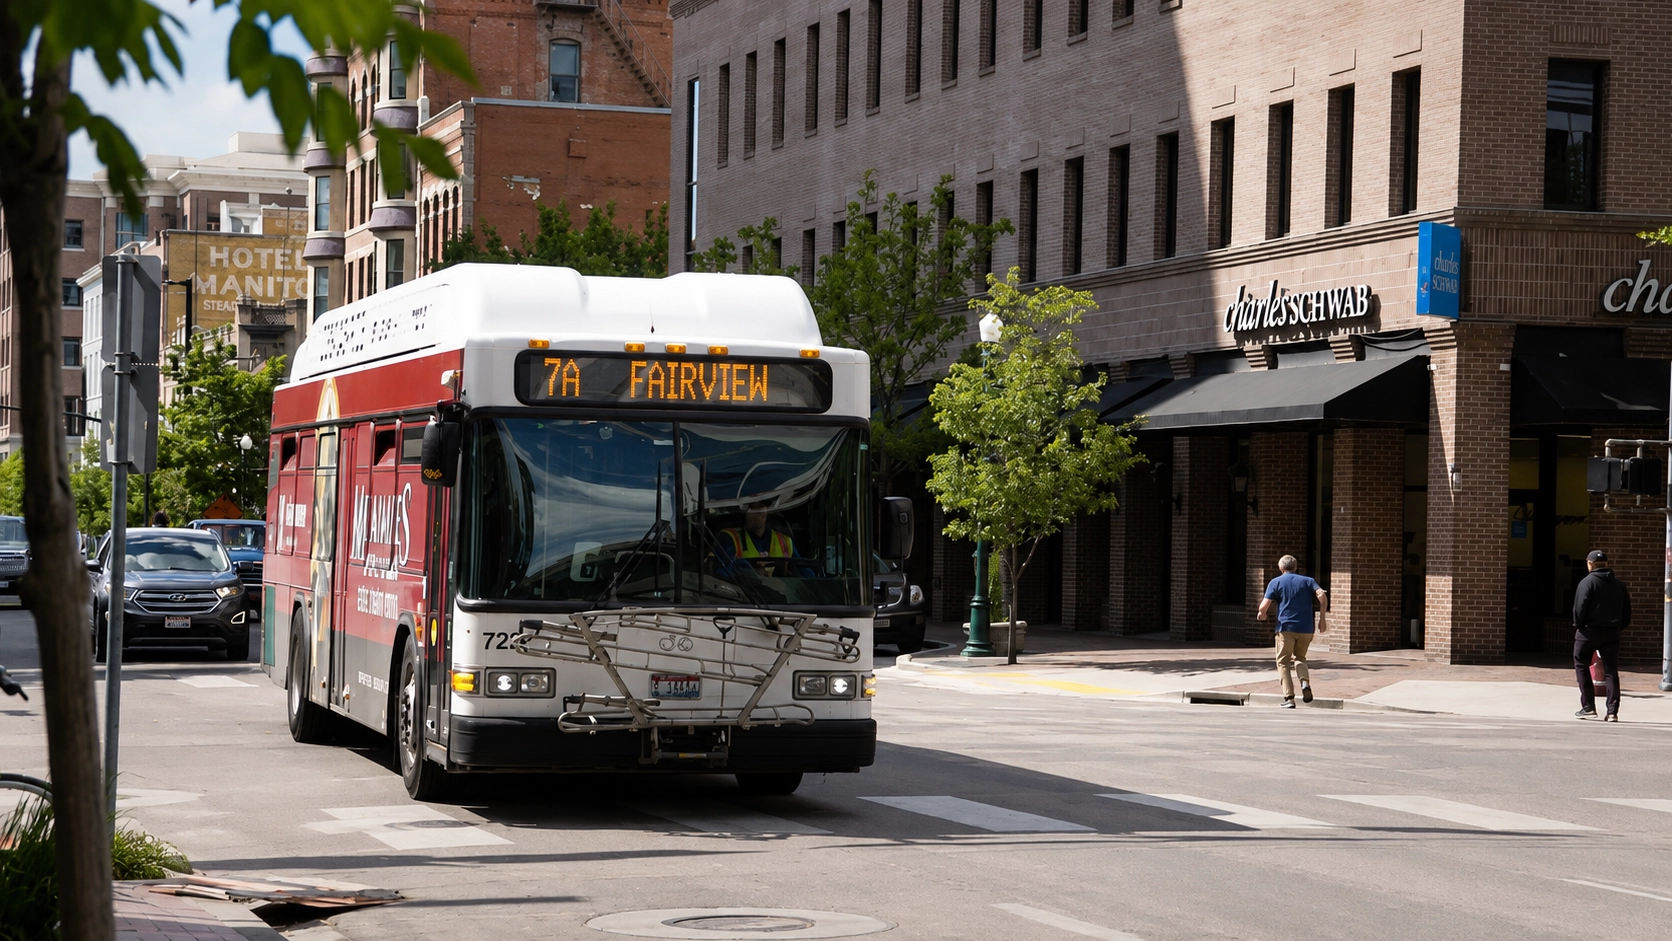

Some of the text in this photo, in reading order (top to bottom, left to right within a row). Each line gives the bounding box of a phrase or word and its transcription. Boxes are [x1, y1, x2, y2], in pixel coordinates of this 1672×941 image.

[209, 246, 307, 271] HOTEL
[1223, 279, 1371, 333] charles SCHWAB
[544, 357, 768, 402] 7A FAIRVIEW
